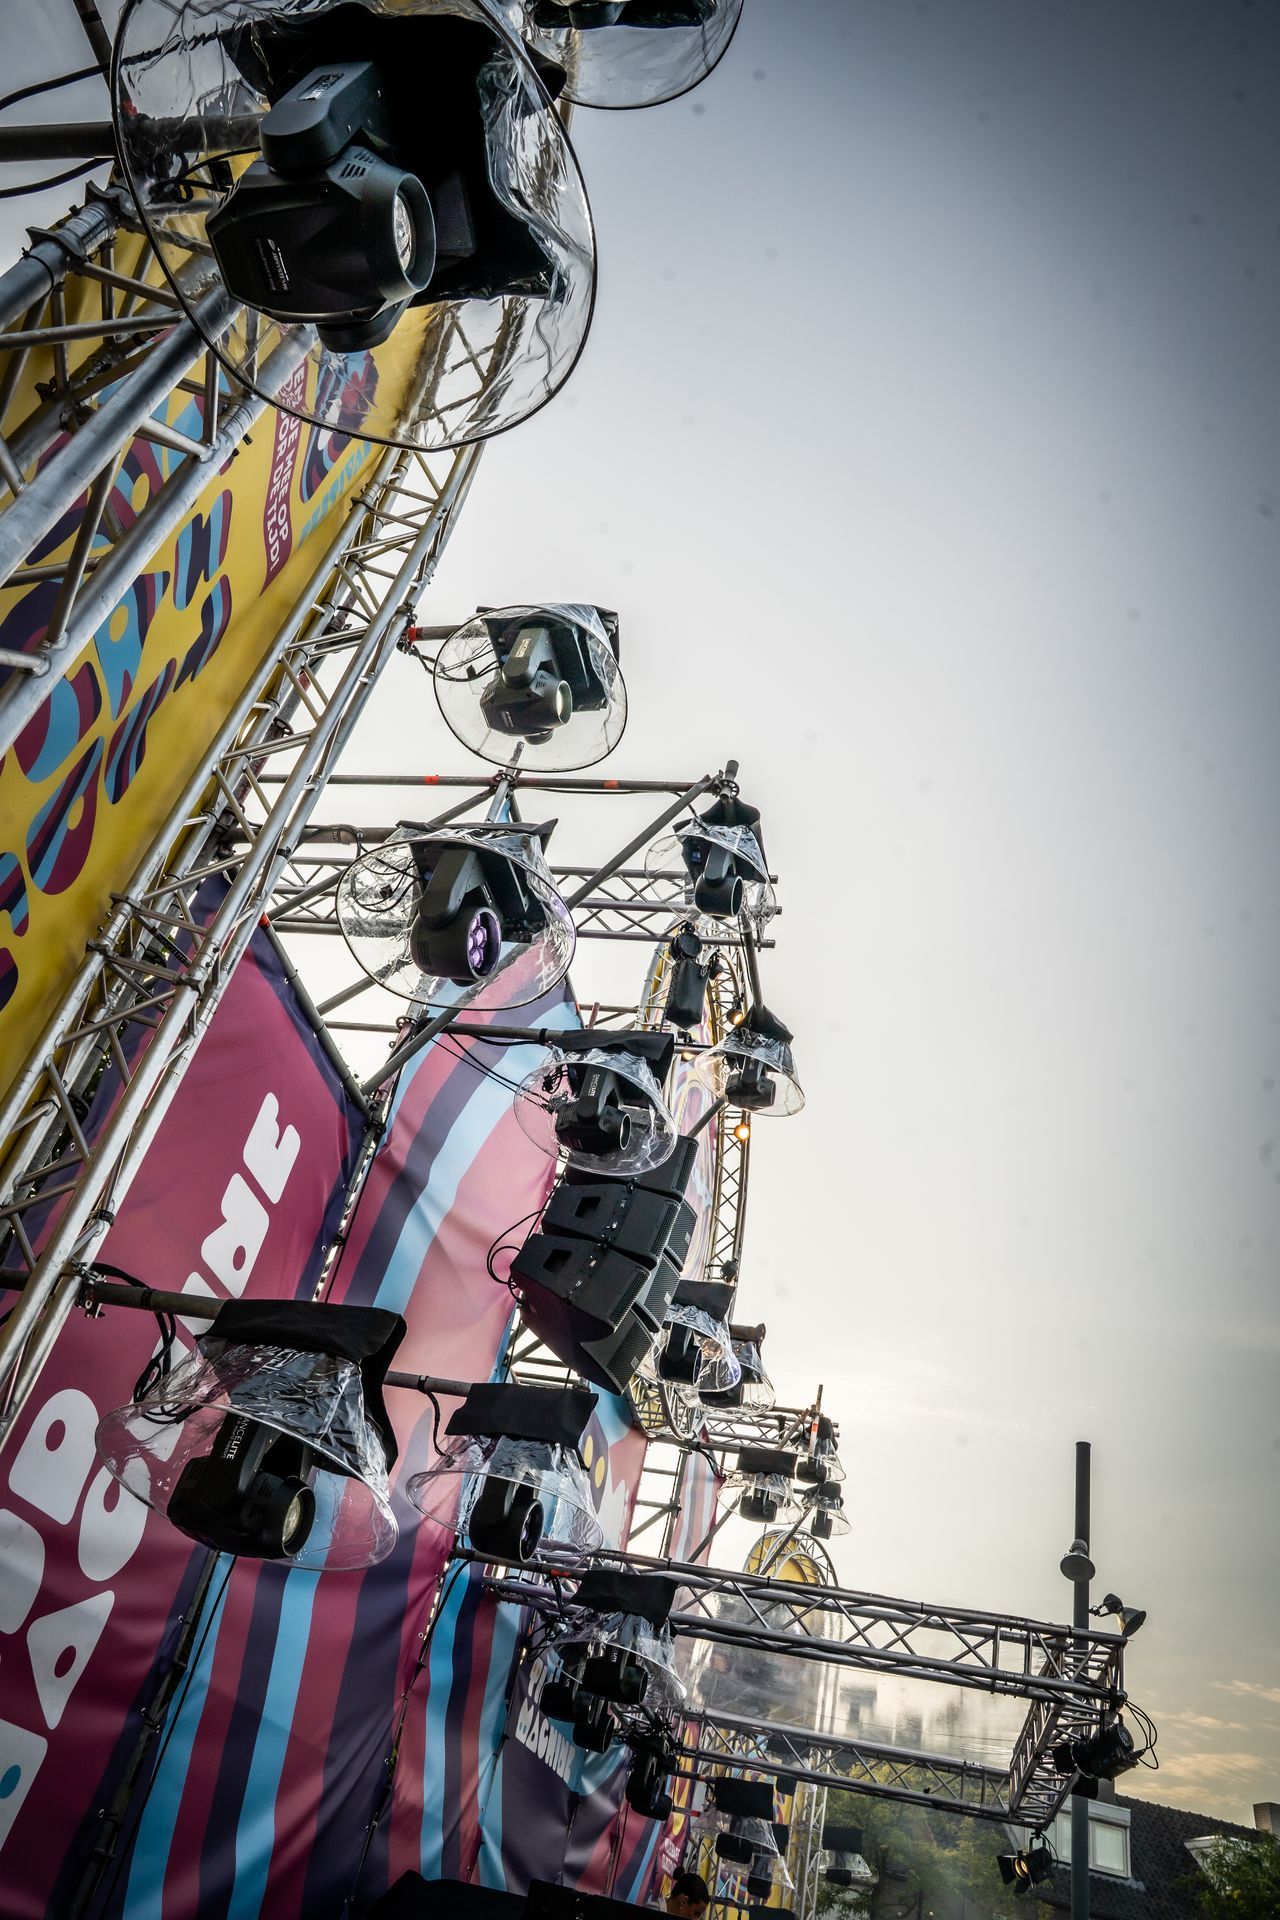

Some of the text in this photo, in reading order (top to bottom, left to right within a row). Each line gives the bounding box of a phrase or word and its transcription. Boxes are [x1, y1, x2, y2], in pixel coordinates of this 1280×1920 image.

[270, 461, 285, 500] DE
[279, 447, 296, 503] MEE
[267, 497, 281, 572] TIJD!
[278, 503, 289, 541] OP
[226, 1416, 250, 1460] ANCELITE
[515, 1697, 576, 1784] MACHINE
